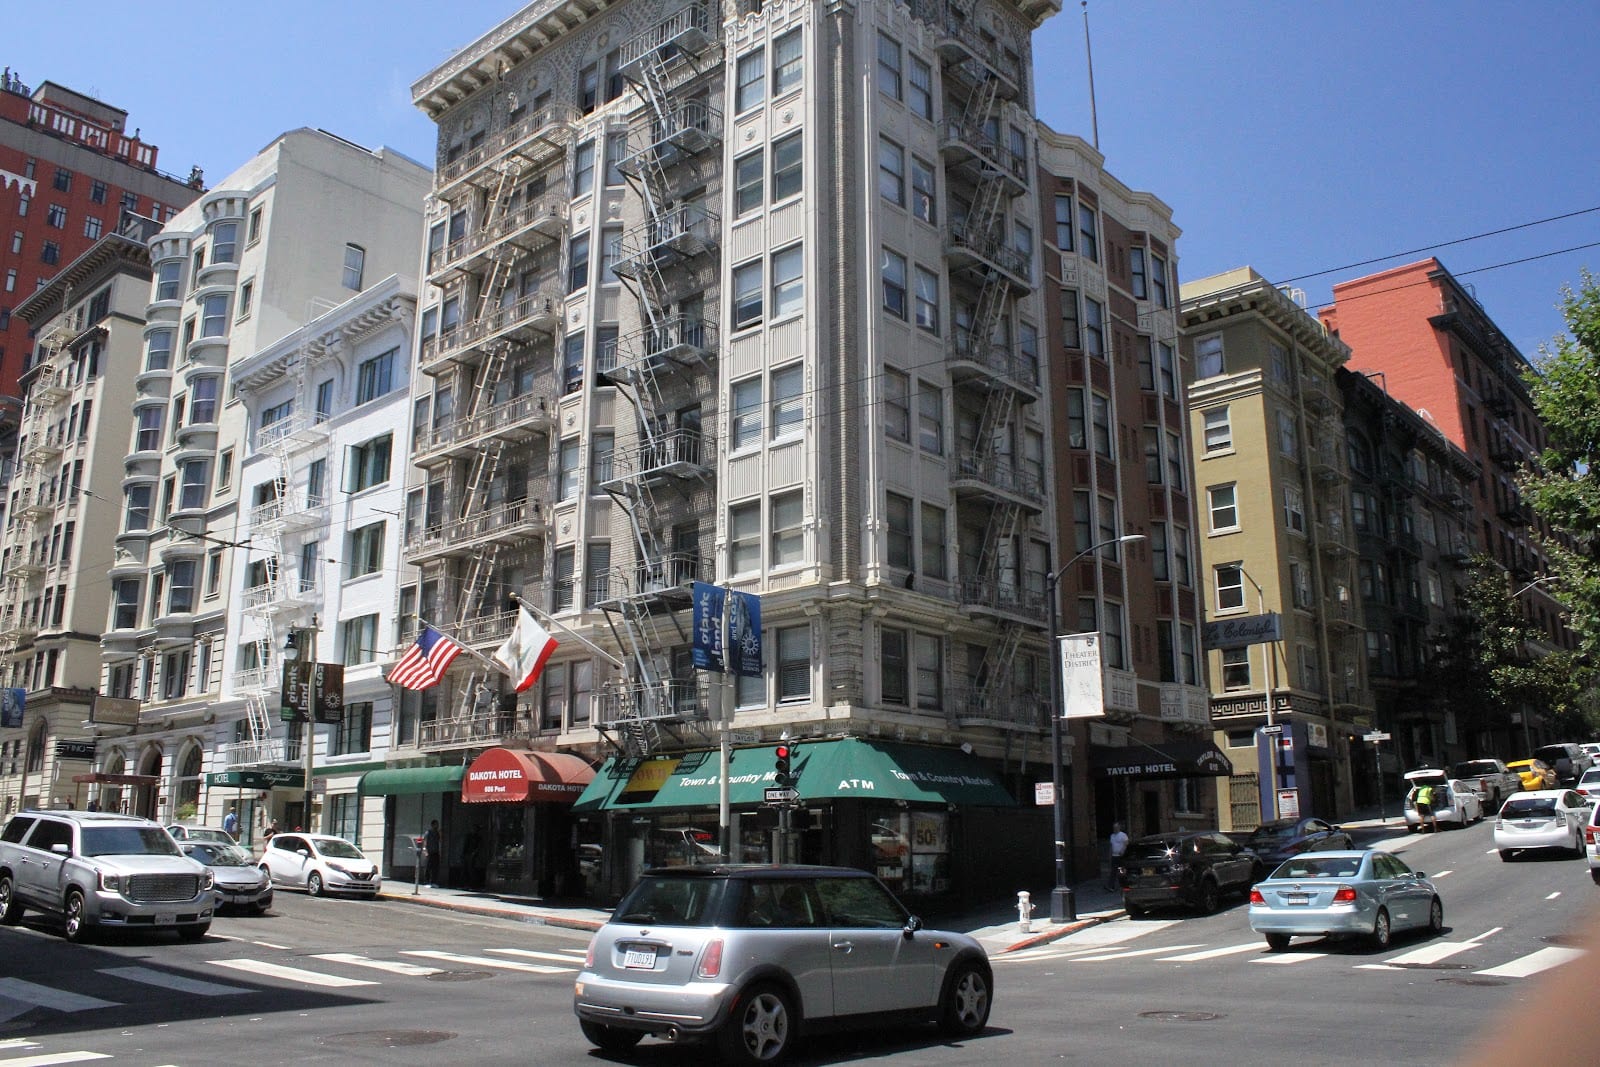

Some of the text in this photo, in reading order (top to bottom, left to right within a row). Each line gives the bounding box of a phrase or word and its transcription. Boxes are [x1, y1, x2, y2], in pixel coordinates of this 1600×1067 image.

[699, 592, 710, 644] giants
[711, 616, 721, 655] land
[1064, 651, 1098, 668] THEATER DISTRICT
[316, 665, 325, 687] sea
[287, 665, 298, 704] giants
[298, 682, 309, 710] land
[470, 769, 522, 780] DAKOTA HOTEL
[1106, 763, 1177, 776] TAYLOR HOTEL
[214, 774, 229, 783] HOTEL
[679, 777, 706, 787] Town
[707, 776, 718, 785] &
[719, 774, 762, 784] ountry
[838, 779, 875, 790] ATM
[538, 783, 566, 791] DAKOTA
